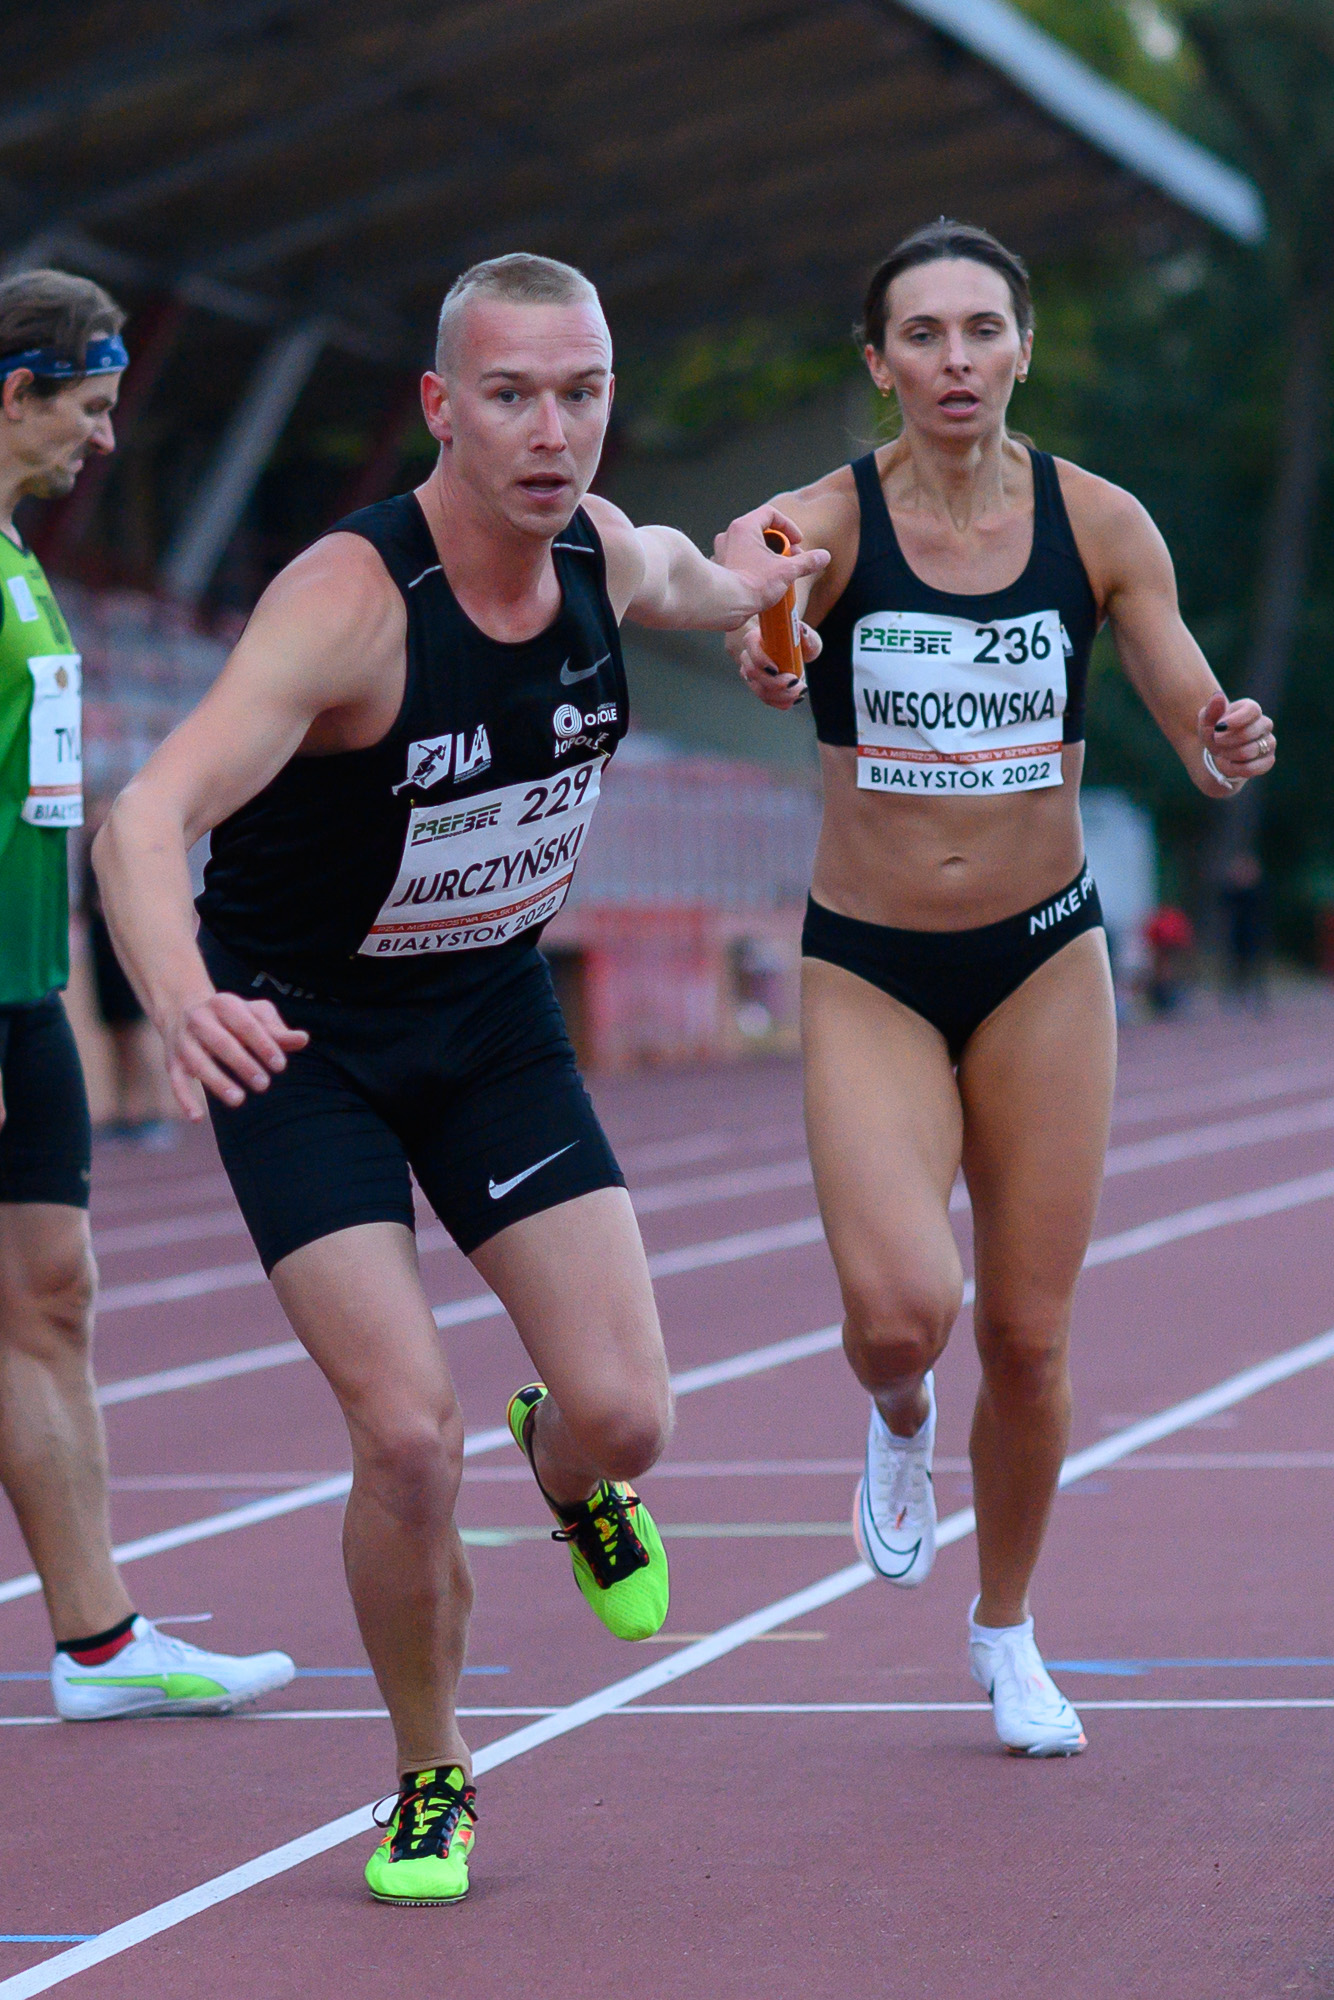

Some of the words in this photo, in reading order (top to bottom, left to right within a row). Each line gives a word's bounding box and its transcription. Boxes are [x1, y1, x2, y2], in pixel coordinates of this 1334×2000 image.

[860, 627, 953, 655] PREFBET
[972, 619, 1052, 665] 236
[583, 708, 618, 726] OOLE
[862, 688, 1056, 730] WESOŁOWSKA
[54, 727, 82, 763] TY
[454, 724, 492, 778] LA
[516, 764, 594, 827] 229
[870, 765, 995, 789] BIAŁYSTOK
[1002, 761, 1051, 786] 2022
[411, 803, 503, 845] PREFBET
[391, 822, 585, 908] JURCZYŃSKI
[376, 922, 510, 953] BIAŁYSTOK
[512, 896, 557, 933] 2022
[406, 915, 480, 931] MISTRZOSTWA
[480, 907, 514, 921] POLSKI
[1029, 887, 1082, 936] NIKE
